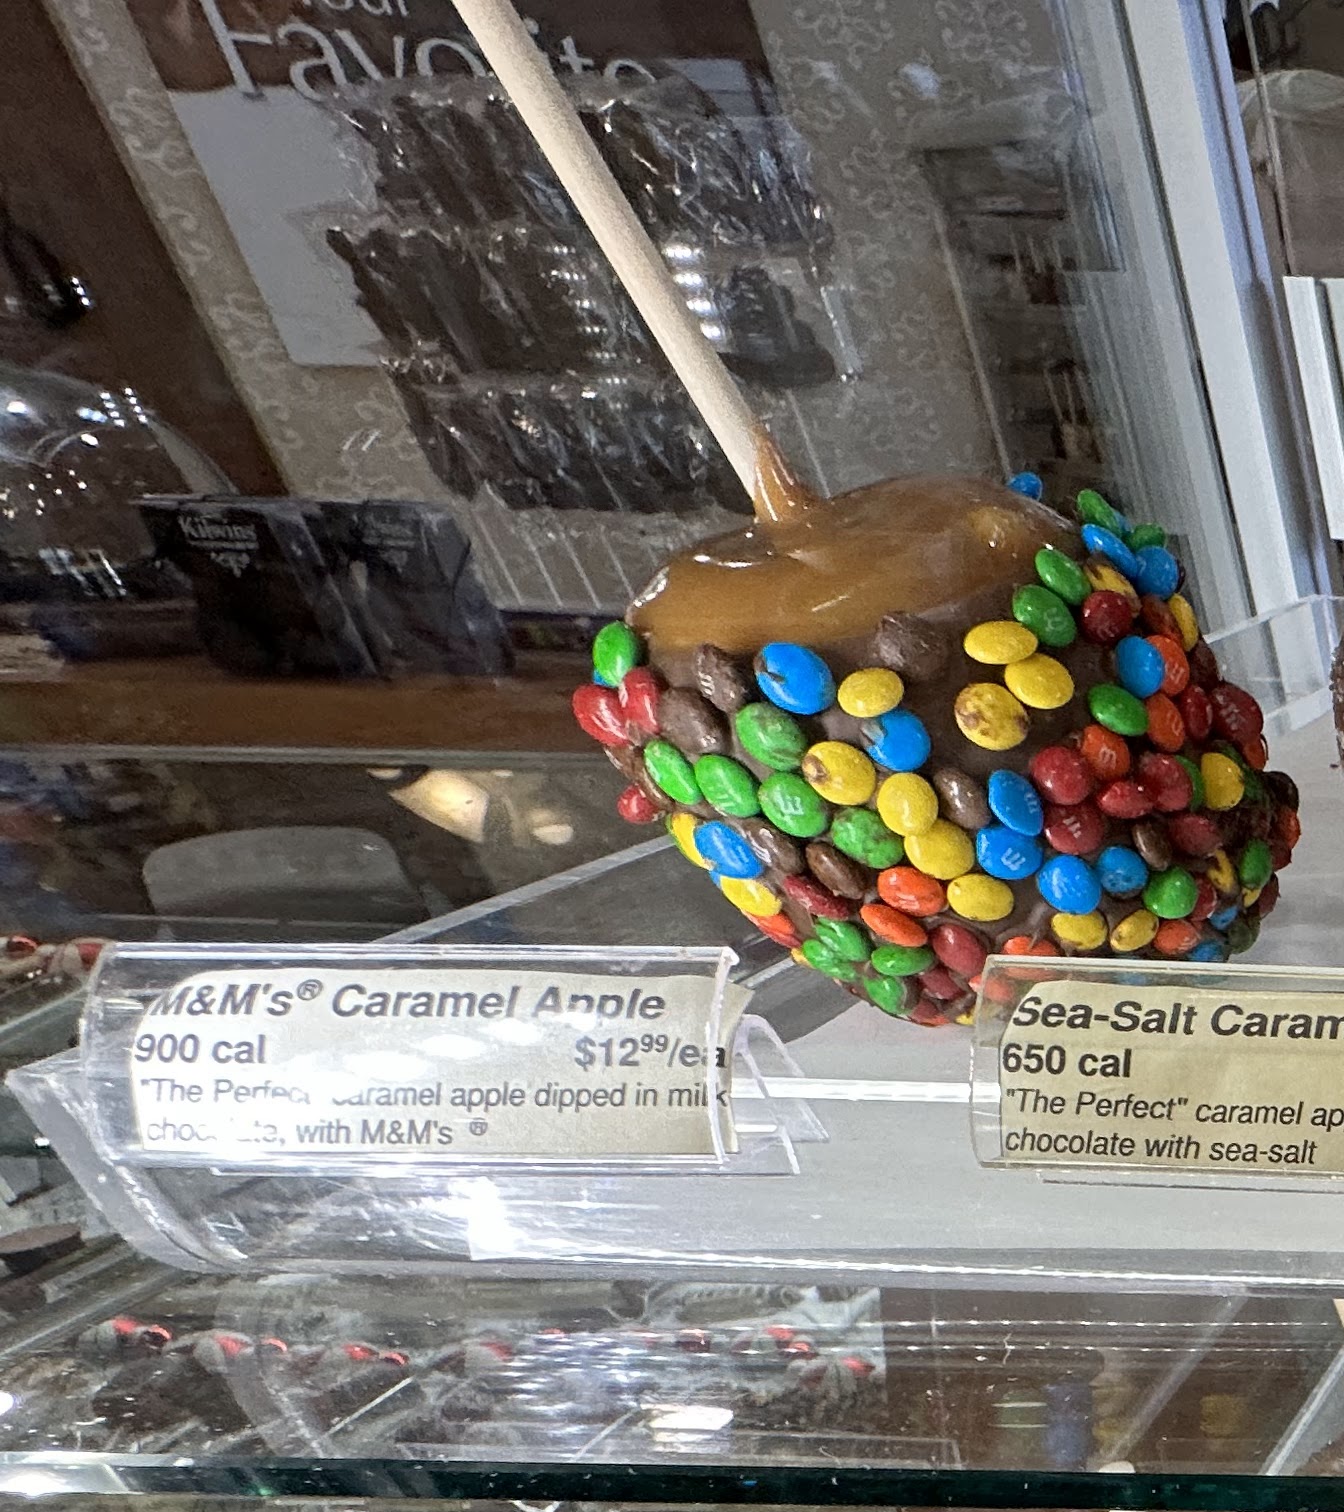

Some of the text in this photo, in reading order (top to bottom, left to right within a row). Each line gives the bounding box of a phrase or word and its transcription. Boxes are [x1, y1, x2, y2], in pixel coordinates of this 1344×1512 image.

[199, 0, 657, 101] Favote
[332, 983, 521, 1018] Caramel
[1012, 996, 1198, 1035] Sea-Salt
[133, 1033, 200, 1063] 900
[211, 1033, 266, 1064] cal
[1002, 1042, 1066, 1074] 650
[1078, 1049, 1132, 1078] cal
[450, 1083, 526, 1113] apple
[535, 1083, 626, 1113] dipped
[636, 1083, 657, 1107] in
[669, 1083, 730, 1108] milk
[1006, 1087, 1066, 1115] "The
[1075, 1091, 1189, 1121] Perfect"
[1195, 1101, 1304, 1125] caramel
[296, 1119, 452, 1145] with M&M's
[1005, 1128, 1318, 1165] chocolate with sea-salt
